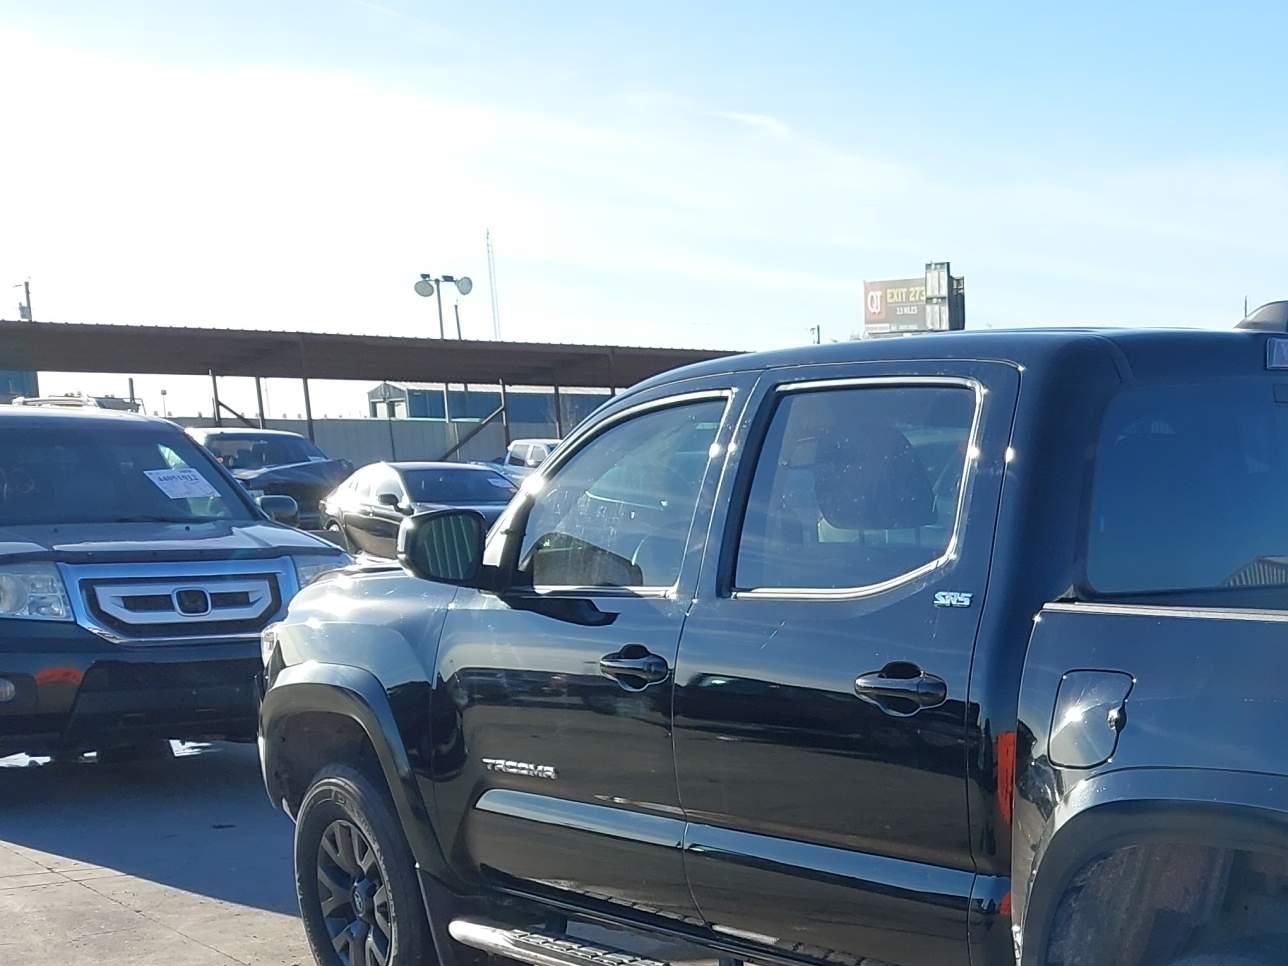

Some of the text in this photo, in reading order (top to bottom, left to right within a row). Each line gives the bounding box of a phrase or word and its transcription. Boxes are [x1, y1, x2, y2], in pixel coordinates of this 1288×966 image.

[868, 291, 882, 313] QT
[886, 288, 907, 303] EXIT
[933, 591, 973, 608] SR5
[482, 758, 557, 780] TACOMA
